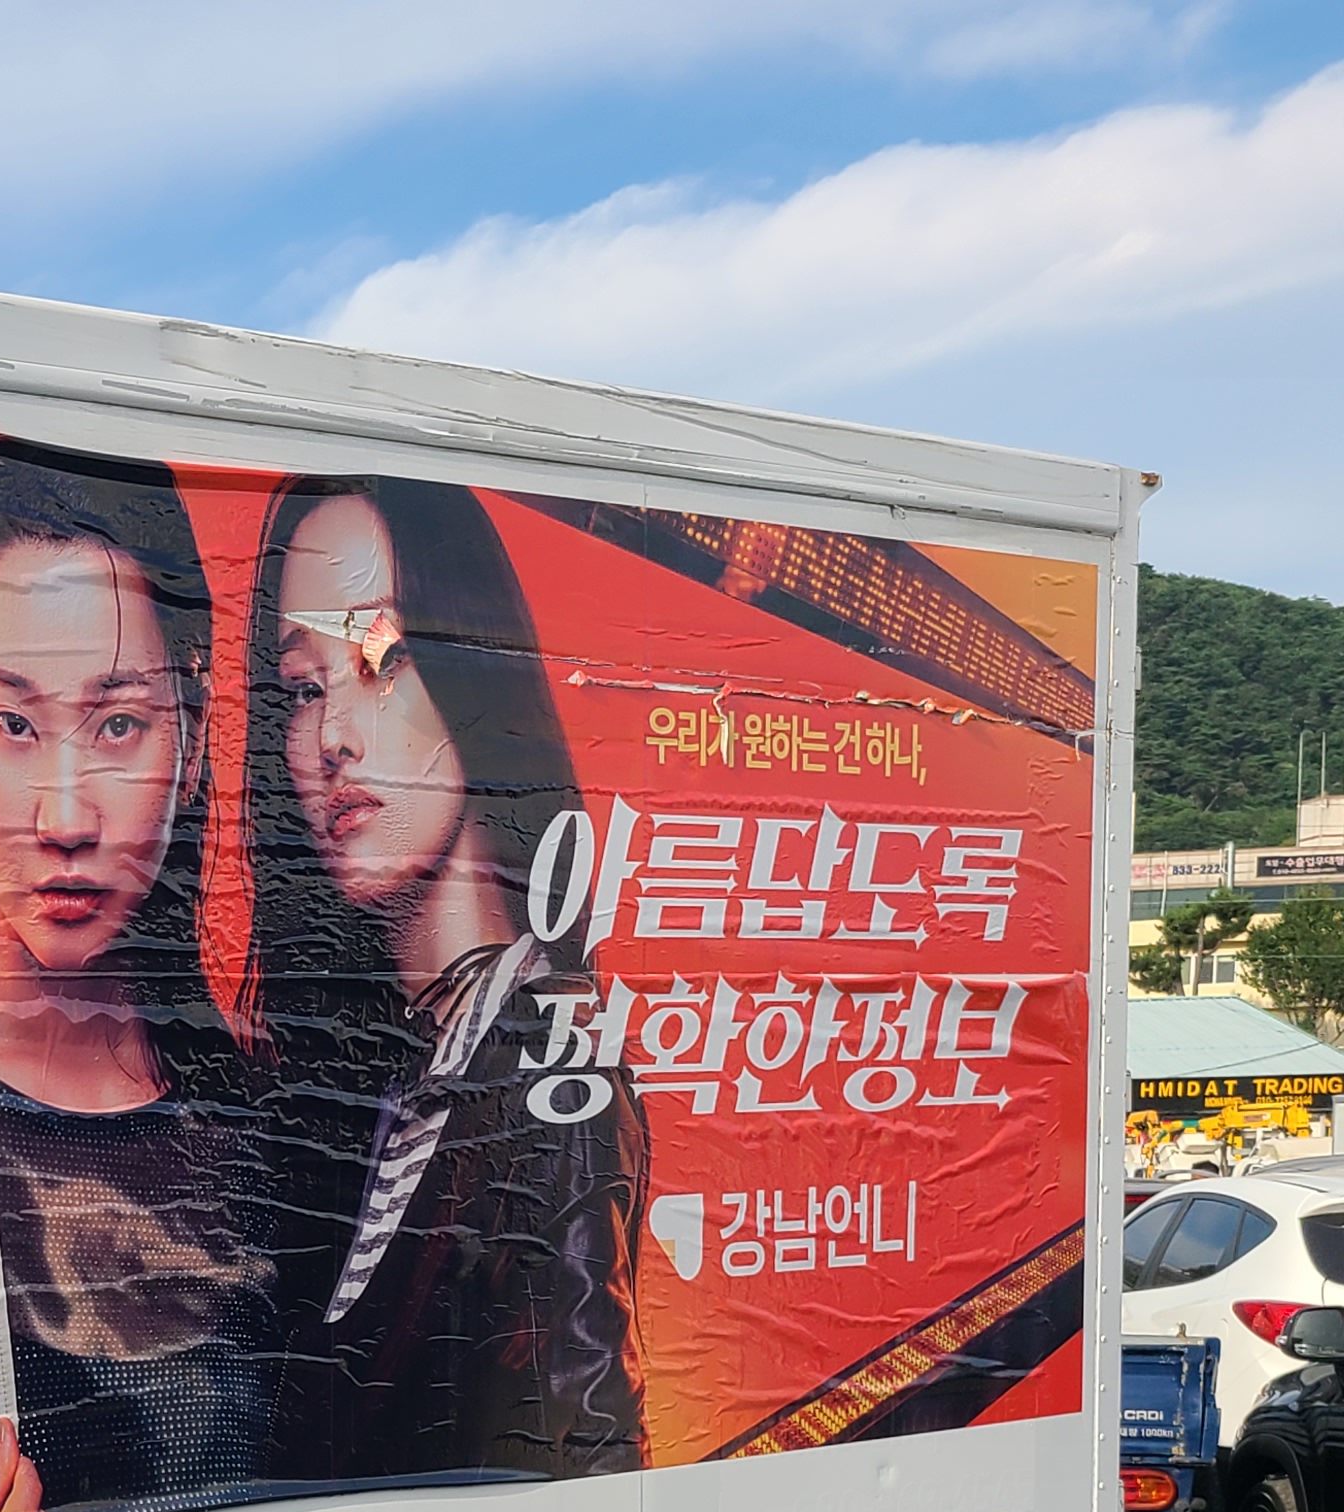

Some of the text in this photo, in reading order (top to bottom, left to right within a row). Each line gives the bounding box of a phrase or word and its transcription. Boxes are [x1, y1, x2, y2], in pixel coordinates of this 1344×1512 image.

[646, 707, 739, 768] 우리가
[742, 712, 830, 772] 원하는
[527, 792, 1023, 965] 아름답도록
[1172, 863, 1228, 875] 833-222
[1253, 1077, 1343, 1095] TRADING
[720, 1180, 918, 1279] 강남언니
